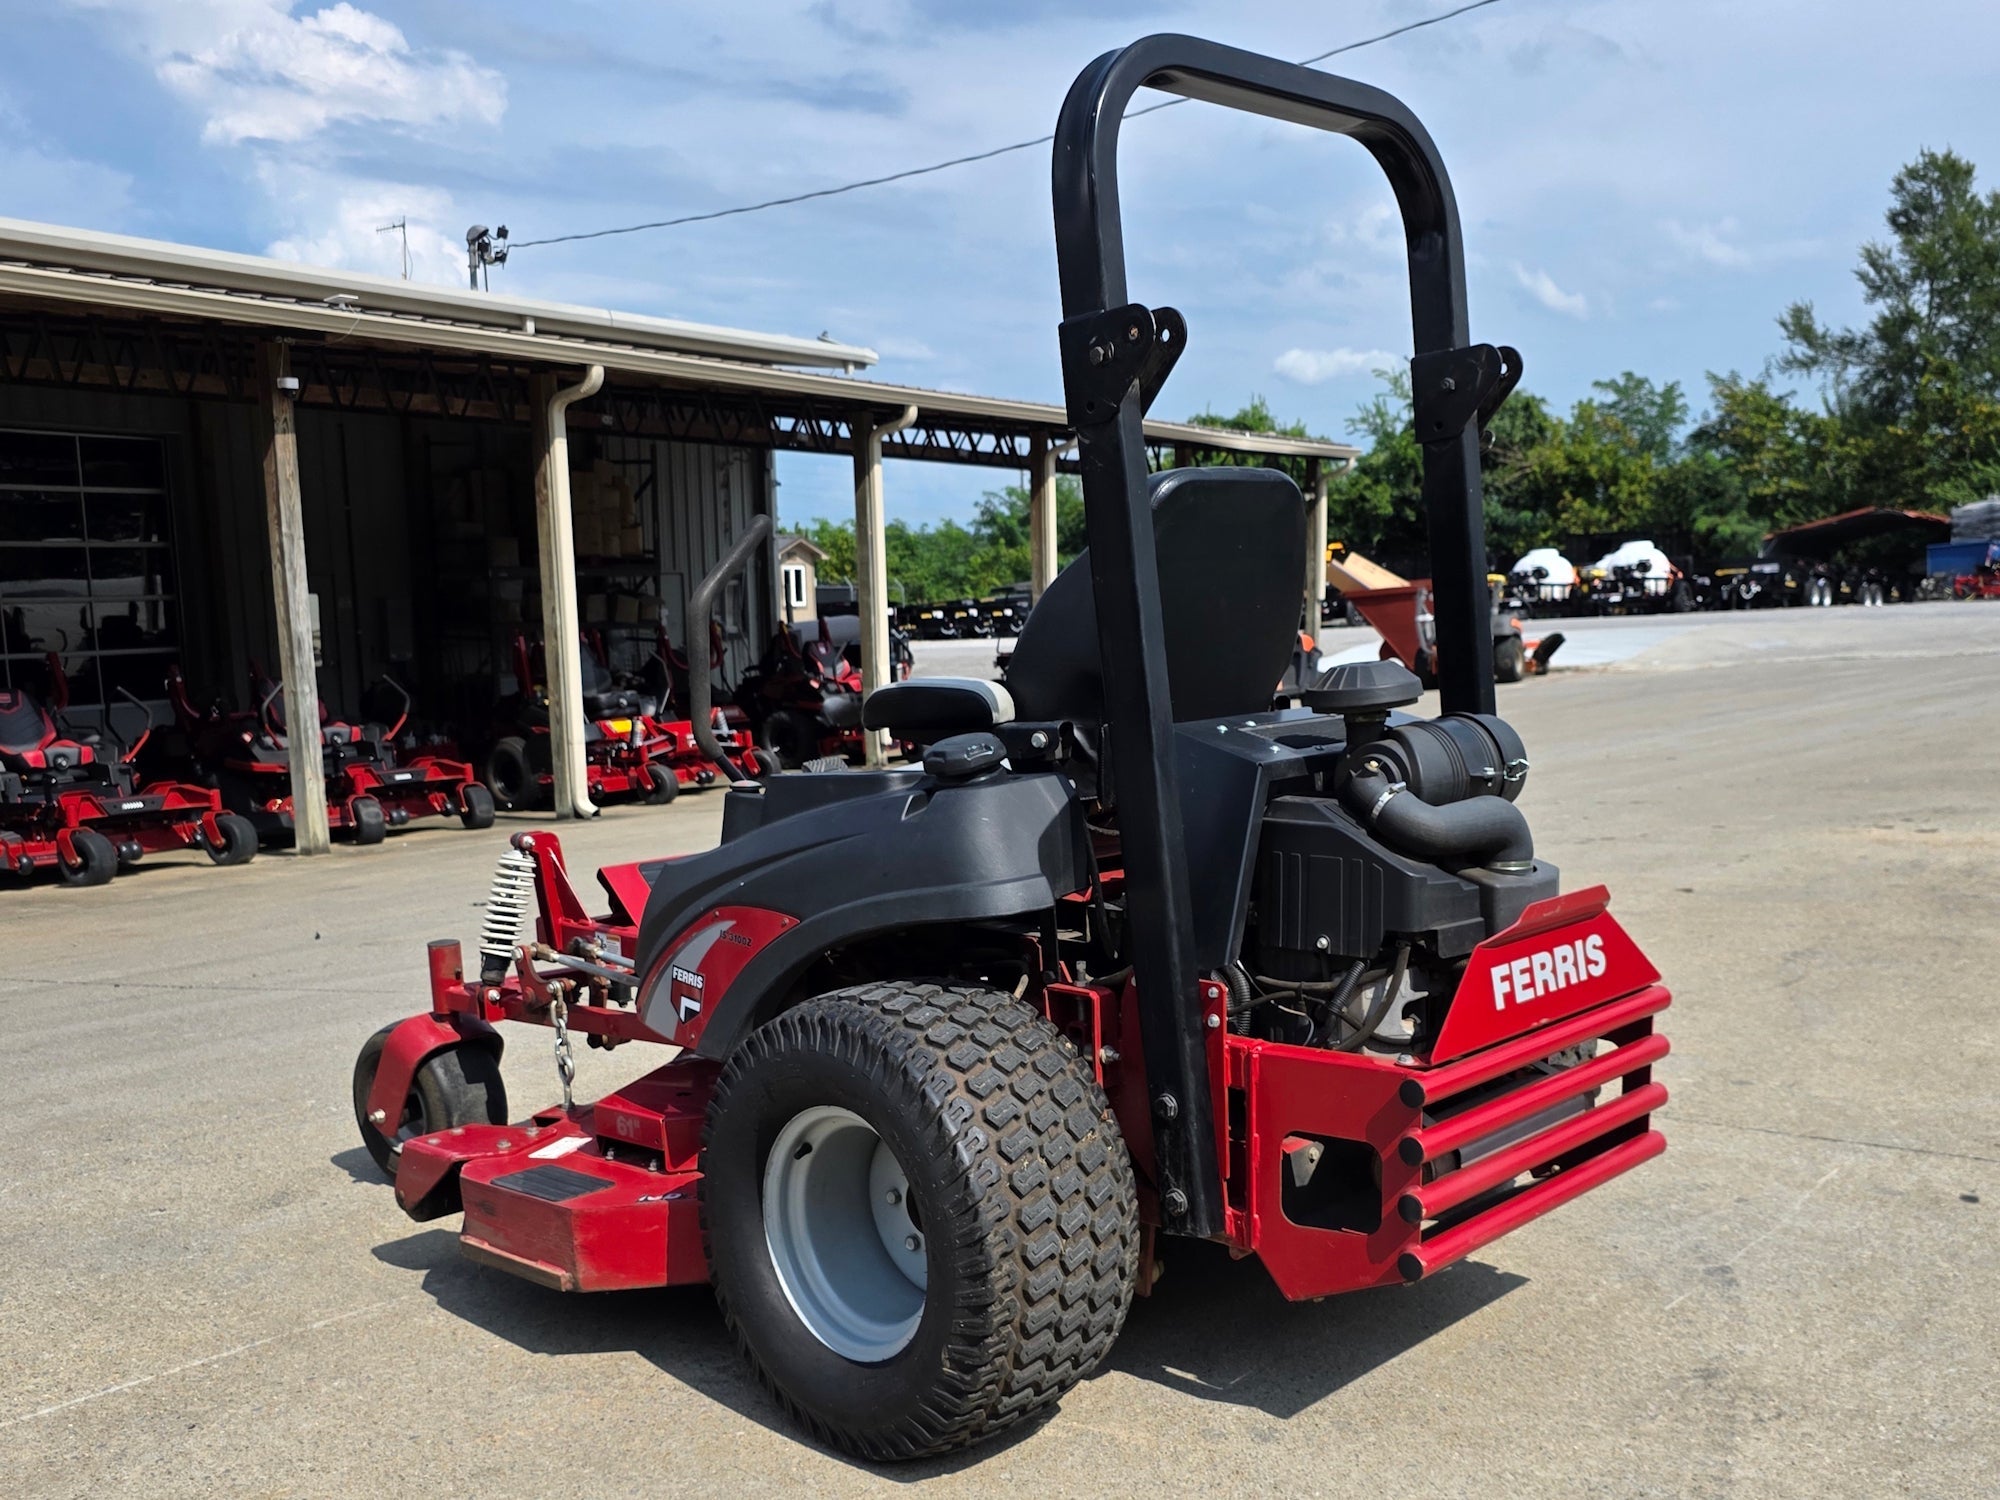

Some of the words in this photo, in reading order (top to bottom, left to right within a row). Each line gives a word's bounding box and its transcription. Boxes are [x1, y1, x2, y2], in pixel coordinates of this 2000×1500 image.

[729, 933, 752, 947] 3100Z
[673, 966, 704, 989] FERRIS
[1490, 934, 1606, 1011] FERRIS
